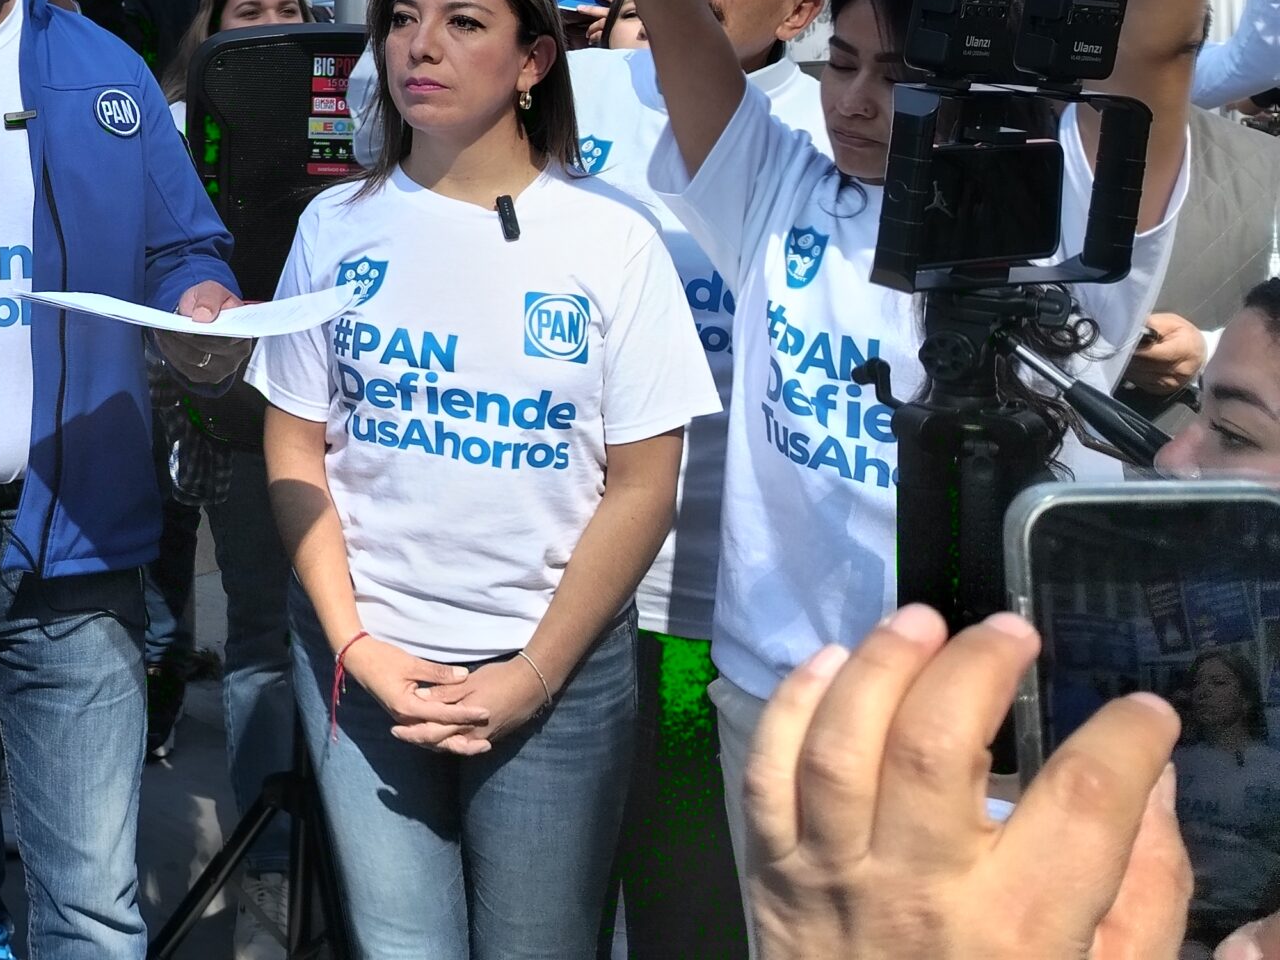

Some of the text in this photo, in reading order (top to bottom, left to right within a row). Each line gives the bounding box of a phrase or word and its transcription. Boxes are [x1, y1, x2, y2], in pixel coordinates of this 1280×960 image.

[965, 35, 991, 49] Ulanzi
[1073, 41, 1103, 55] Ulanzi
[101, 98, 135, 125] PAN
[333, 317, 458, 372] #PAN
[538, 307, 581, 345] PAN
[338, 361, 577, 431] Defiende
[767, 354, 897, 444] Defie
[342, 401, 569, 471] TusAhorros
[762, 401, 900, 489] TusAh
